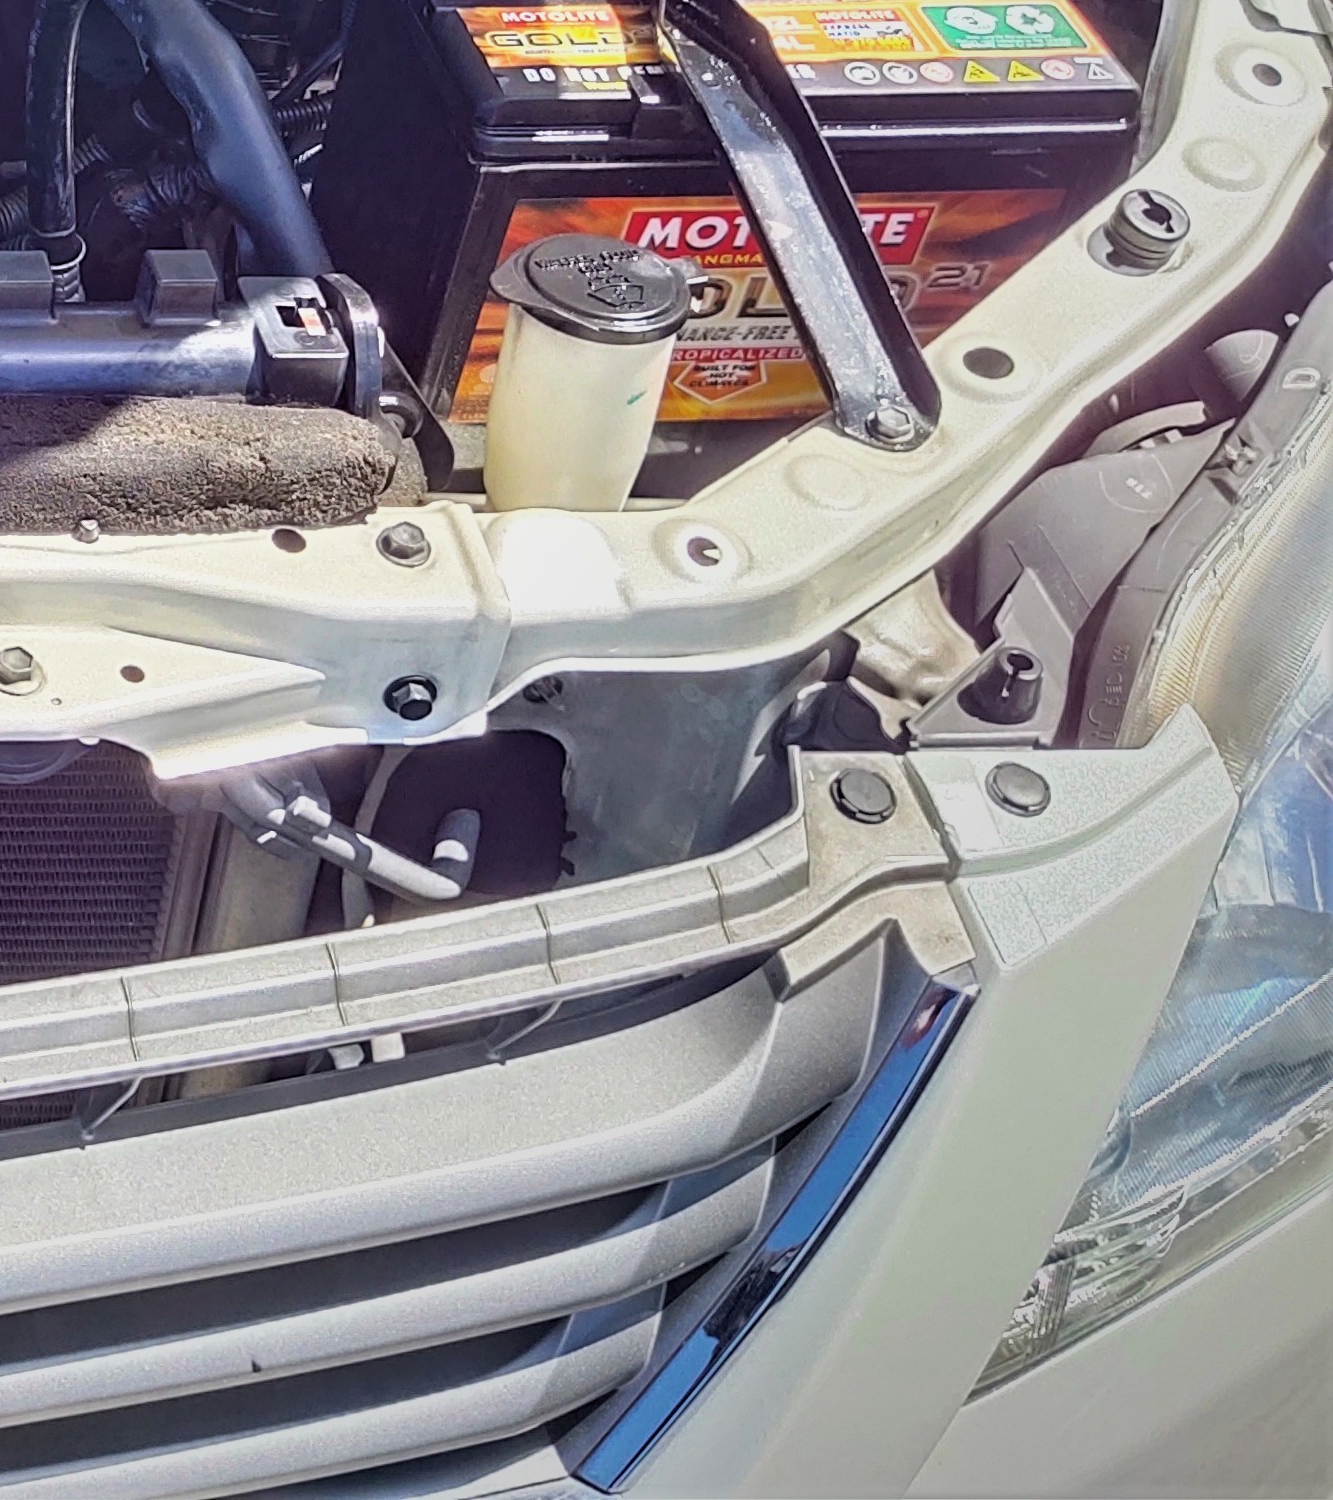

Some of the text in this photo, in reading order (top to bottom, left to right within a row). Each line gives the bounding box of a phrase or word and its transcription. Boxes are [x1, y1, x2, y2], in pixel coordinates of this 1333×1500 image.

[501, 10, 611, 23] MOTOLITE
[814, 9, 897, 20] MOTOLITE
[488, 30, 634, 48] GOLD
[522, 67, 557, 82] DO
[563, 67, 610, 82] NOT
[636, 212, 915, 249] MOTTE
[926, 262, 990, 289] 21
[673, 347, 804, 361] ROPICALIZED
[693, 363, 758, 372] BUILT FOR
[708, 371, 736, 379] HOT
